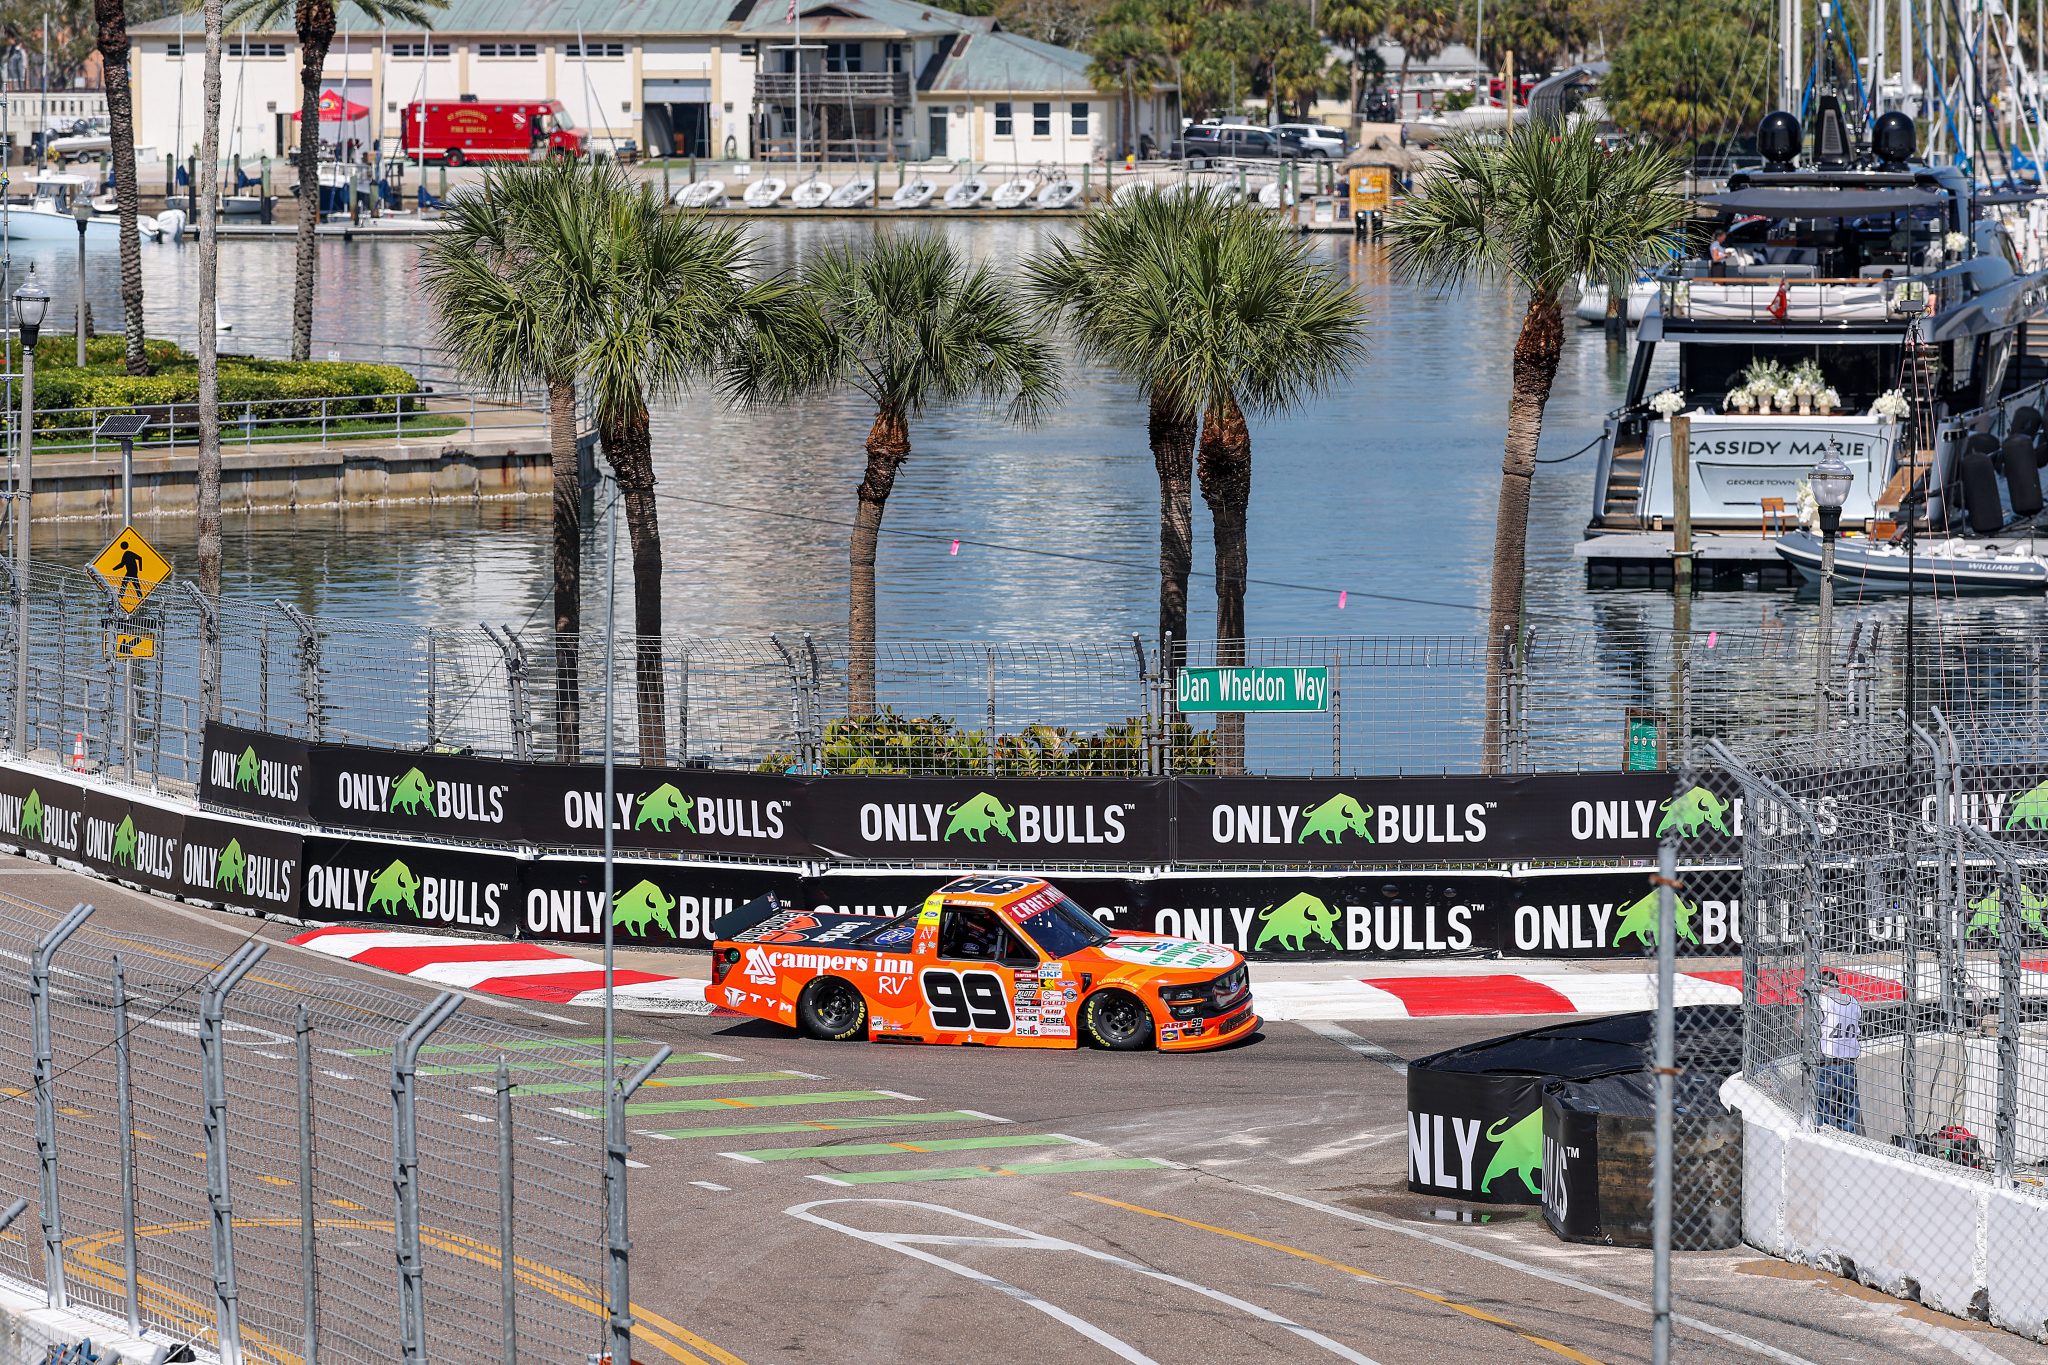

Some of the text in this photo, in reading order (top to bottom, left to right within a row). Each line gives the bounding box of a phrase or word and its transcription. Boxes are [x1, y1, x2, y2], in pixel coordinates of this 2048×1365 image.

[1968, 562, 2020, 572] WILLIAMS
[1180, 669, 1326, 709] Dan Wheldon Way
[210, 749, 237, 789] ONLY
[338, 771, 390, 812] ONLY
[85, 815, 116, 863] ONLY
[860, 802, 944, 842] ONLY
[1211, 804, 1300, 844] ONLY
[1570, 800, 1657, 840] ONLY
[183, 843, 218, 889] ONLY
[307, 864, 370, 912] ONLY
[527, 888, 608, 934] ONLY
[1514, 903, 1613, 950] ONLY
[770, 951, 914, 976] campers inn
[921, 968, 1014, 1033] 99
[1161, 1021, 1188, 1029] ARP
[1192, 1018, 1204, 1028] 99
